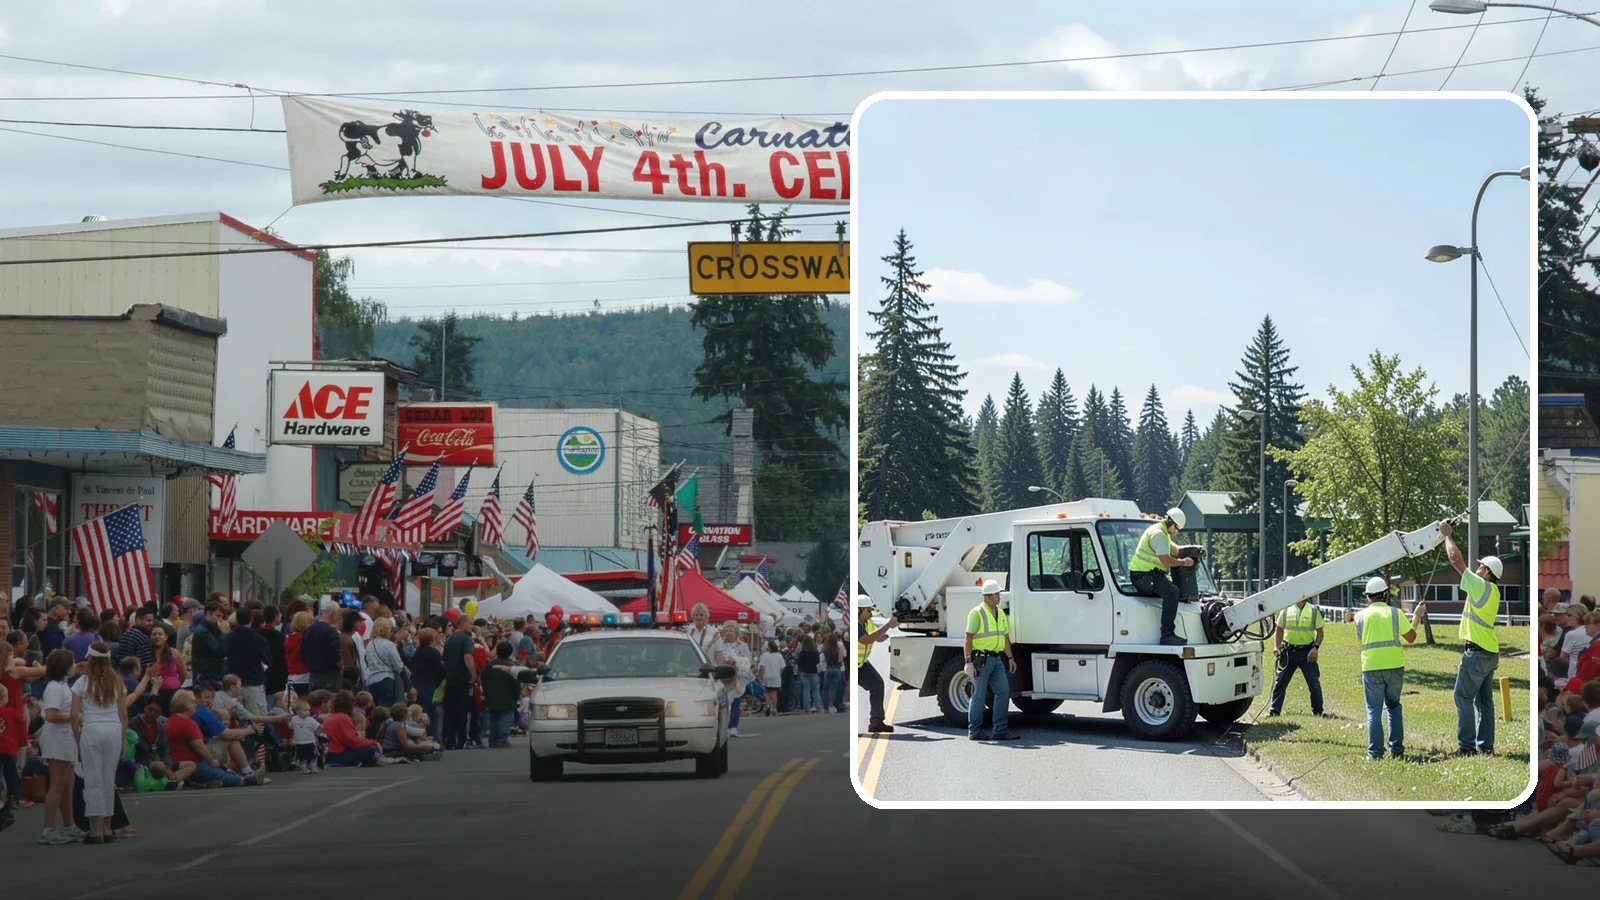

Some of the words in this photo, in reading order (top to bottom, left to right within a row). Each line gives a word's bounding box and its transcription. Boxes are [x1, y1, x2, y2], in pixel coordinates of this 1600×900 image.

[481, 141, 605, 192] JULY
[632, 150, 746, 197] 4th.
[697, 254, 850, 280] CROSSWA
[282, 380, 374, 420] ACE
[406, 409, 452, 421] CEDAR
[461, 409, 485, 421] LOG
[283, 421, 370, 436] Hardware
[416, 428, 477, 446] Coca-Cola
[354, 467, 385, 480] Simpl
[83, 486, 93, 494] St.
[96, 485, 124, 494] Vincent
[126, 486, 135, 494] de
[138, 486, 155, 495] Paul
[81, 503, 153, 521] THT
[688, 526, 741, 535] CRNATION
[699, 535, 730, 543] GLASS
